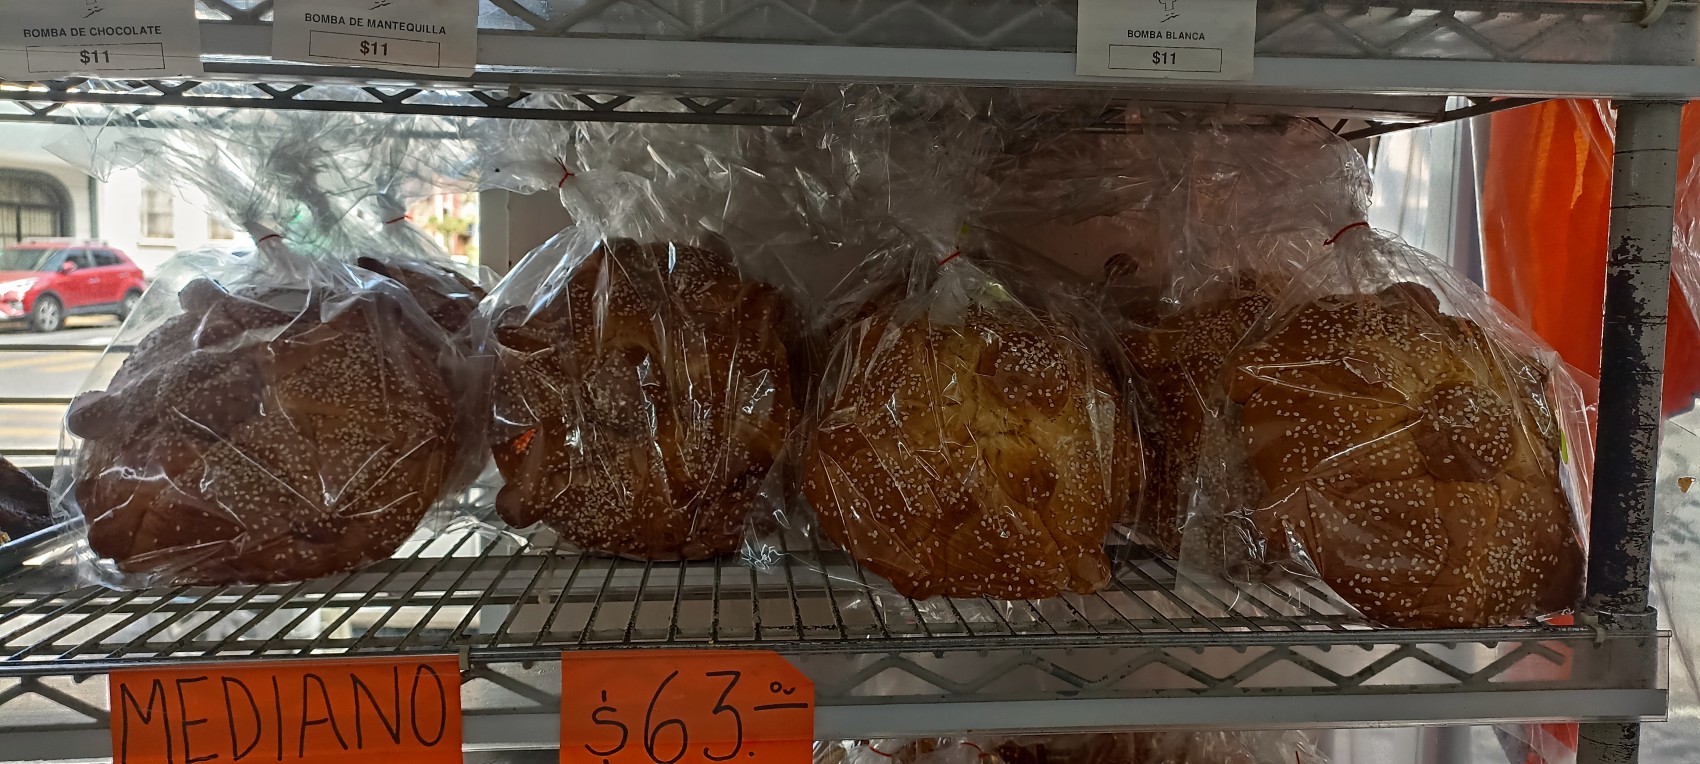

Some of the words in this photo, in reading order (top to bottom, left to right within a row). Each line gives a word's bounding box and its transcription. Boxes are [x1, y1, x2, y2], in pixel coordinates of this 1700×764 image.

[23, 28, 67, 38] BOMBA
[71, 27, 86, 37] DE
[89, 25, 162, 36] CHOCOLATE
[304, 13, 346, 25] BOMBA
[349, 17, 364, 27] DE
[367, 19, 447, 35] MANTEQUILLA
[1127, 29, 1163, 39] BOMBA
[1165, 31, 1206, 41] BLANCA
[360, 40, 388, 56] $11
[80, 50, 110, 65] $11
[1152, 51, 1177, 65] $11
[120, 663, 447, 764] MEDIANO
